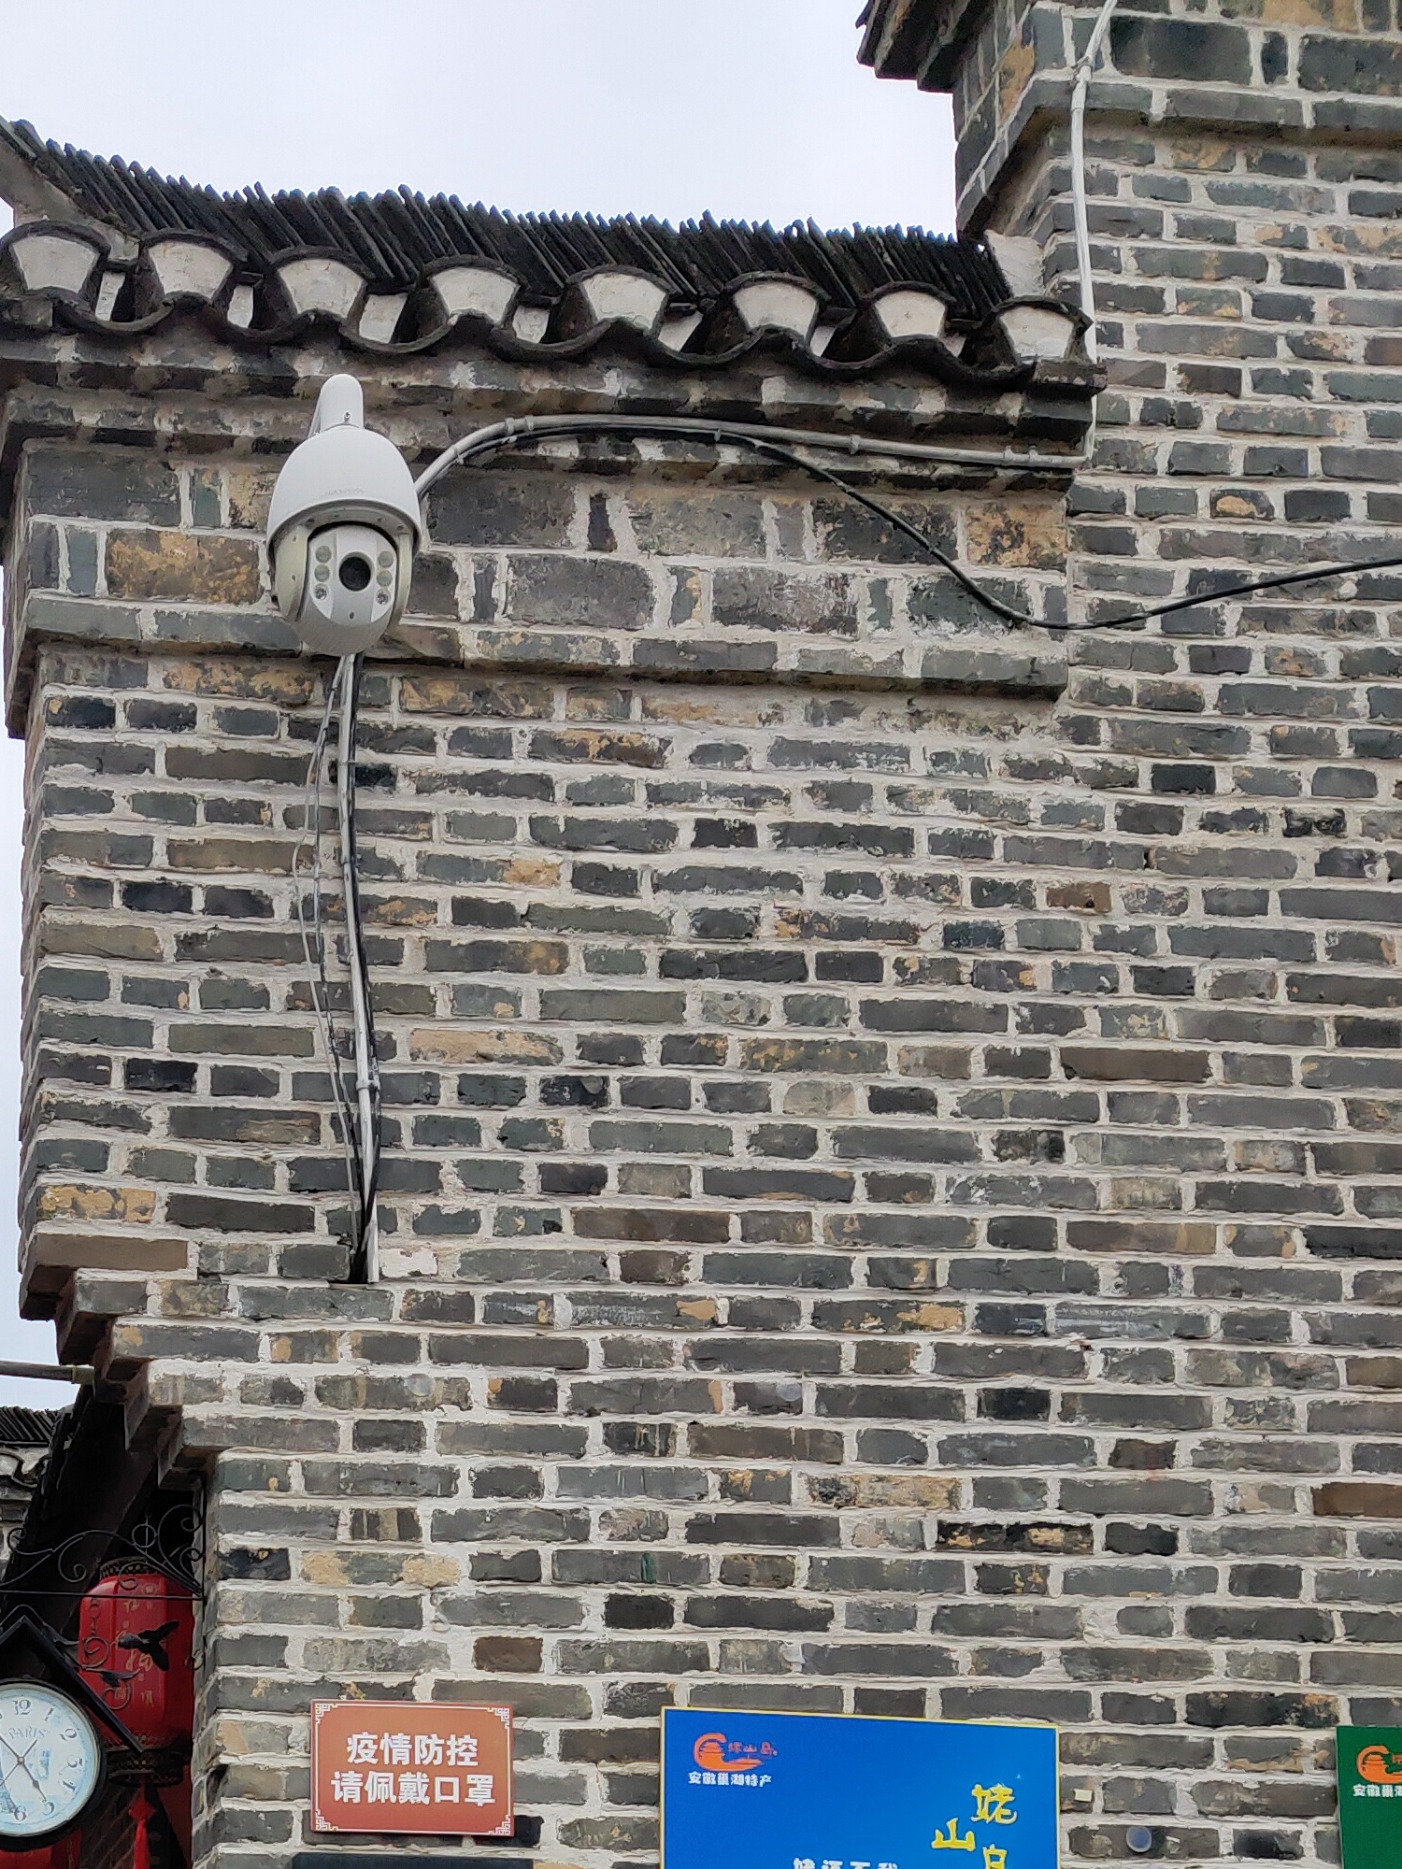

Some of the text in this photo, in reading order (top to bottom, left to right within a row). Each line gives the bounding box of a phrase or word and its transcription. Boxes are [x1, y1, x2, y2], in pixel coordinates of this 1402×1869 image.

[13, 1700, 31, 1715] 12
[45, 1707, 54, 1721] 1
[346, 1733, 479, 1767] 疫情防控
[331, 1771, 495, 1807] 请佩戴口罩
